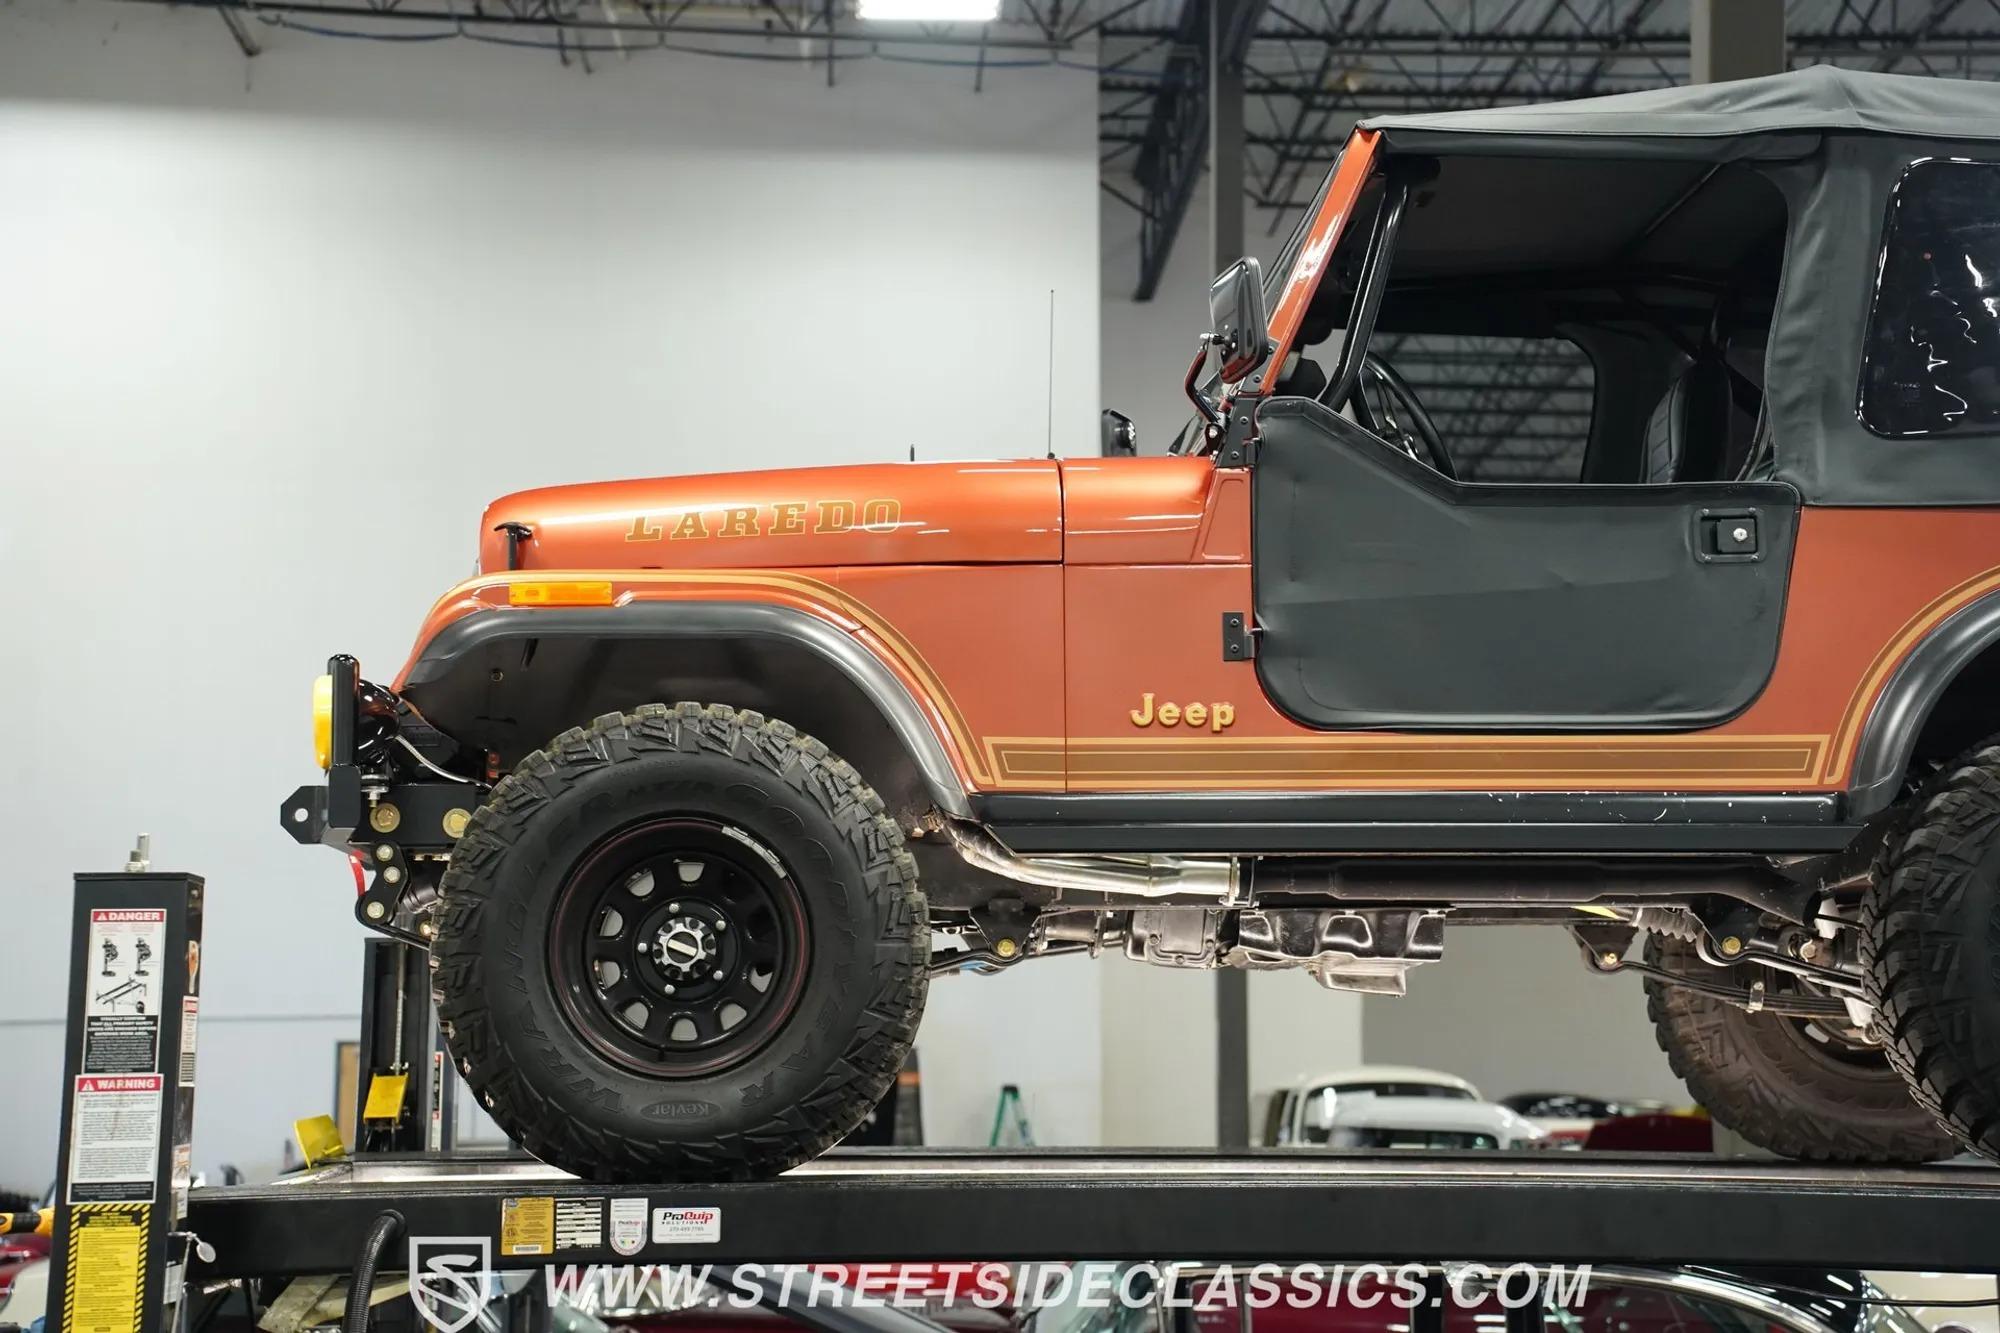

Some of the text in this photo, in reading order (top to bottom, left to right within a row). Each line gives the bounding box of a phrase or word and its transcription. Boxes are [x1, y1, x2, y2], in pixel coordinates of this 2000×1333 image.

[625, 499, 901, 542] LAREDO
[1130, 692, 1236, 733] Jeep
[109, 912, 160, 921] DANGER
[97, 1079, 156, 1089] WARNING
[652, 1104, 709, 1117] Kevlar
[663, 1211, 713, 1224] ProQuip
